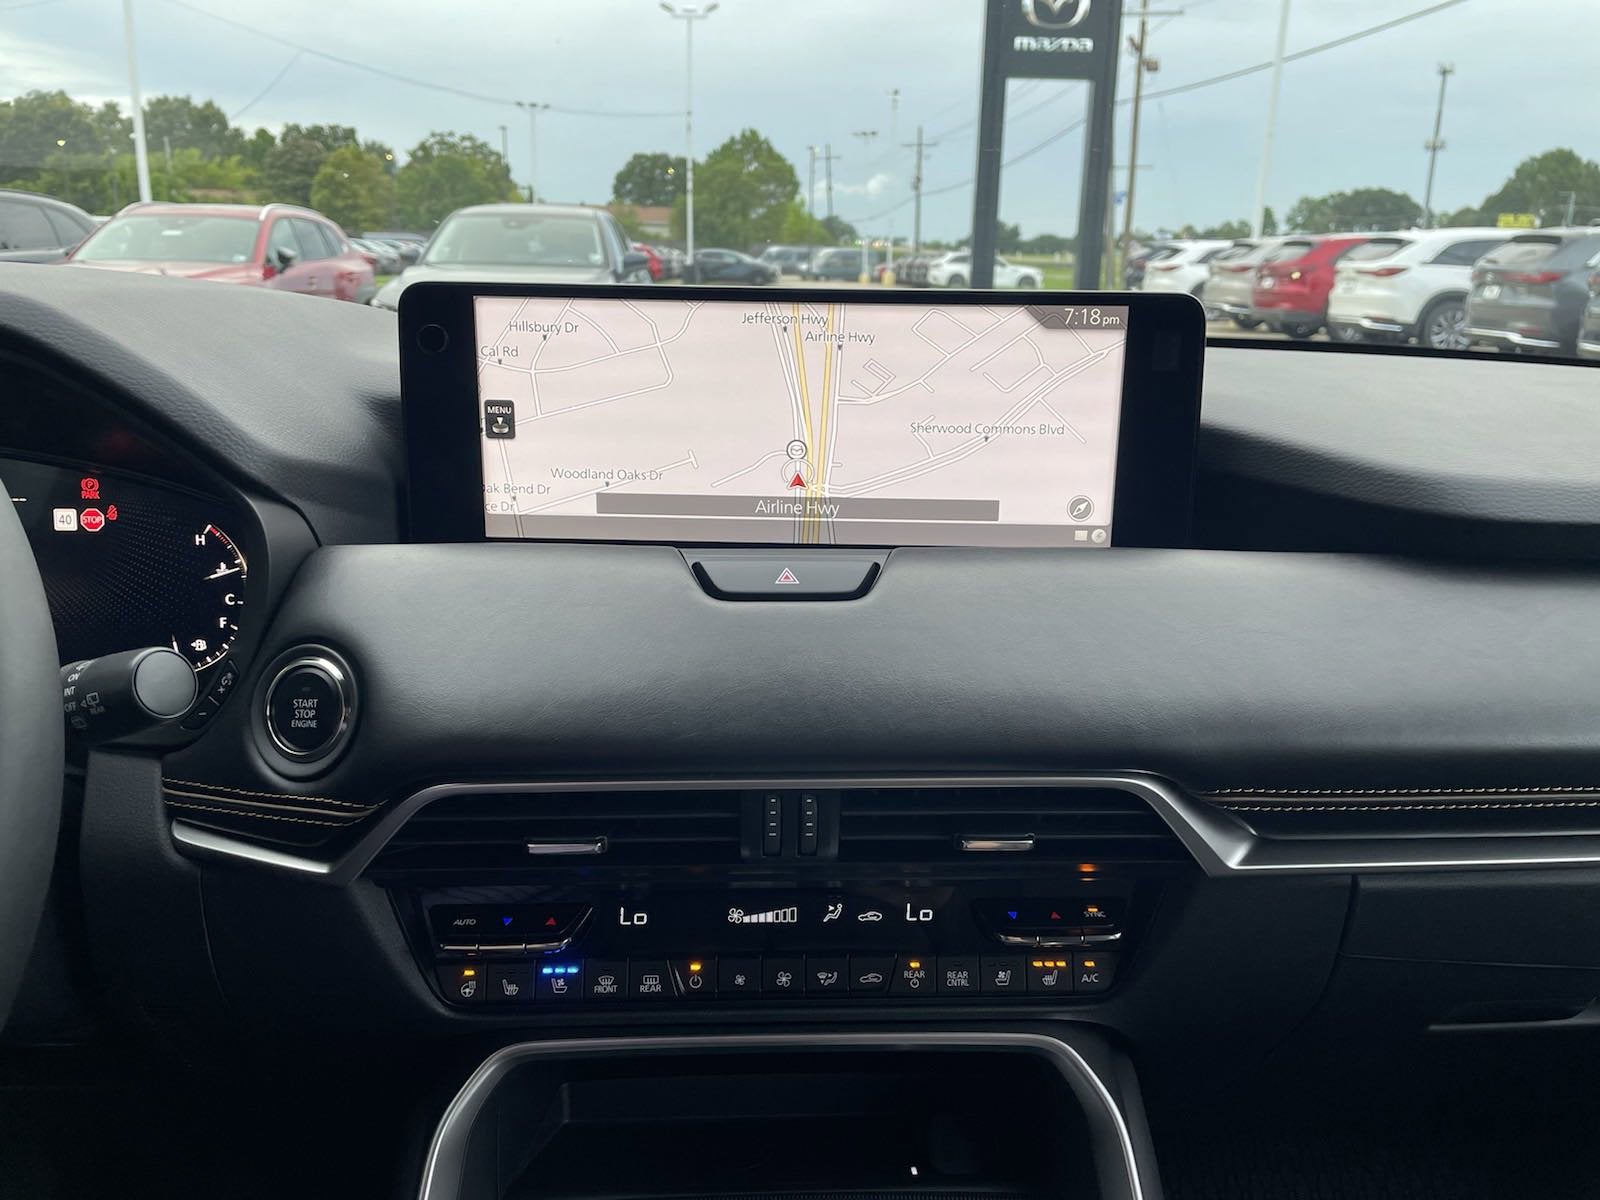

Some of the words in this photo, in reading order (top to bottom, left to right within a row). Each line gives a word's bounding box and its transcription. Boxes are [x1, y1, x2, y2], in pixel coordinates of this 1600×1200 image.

[742, 311, 798, 325] Jefferson
[801, 314, 829, 327] Hwy
[1064, 308, 1101, 325] 7:18
[1102, 316, 1120, 327] pm
[509, 320, 562, 336] Hillsbury
[564, 322, 579, 334] Dr
[805, 330, 845, 342] Airline
[849, 332, 876, 345] Hwy
[480, 345, 499, 358] Cal
[503, 346, 519, 357] Rd
[487, 406, 512, 415] MENU
[910, 421, 972, 434] Sherwood
[974, 423, 1037, 435] Commons
[1039, 423, 1066, 435] Blvd
[550, 467, 614, 480] Woodland
[617, 469, 647, 481] Oaks
[649, 469, 664, 481] Dr
[503, 482, 534, 495] Bend
[537, 484, 552, 495] Dr
[81, 490, 101, 499] PARK
[501, 500, 515, 512] Dr
[755, 499, 802, 515] Airline
[806, 501, 840, 519] Hwy
[58, 514, 72, 525] 40
[82, 515, 103, 525] STOP
[195, 534, 206, 546] H
[224, 593, 236, 606] C
[219, 616, 228, 629] F
[63, 686, 76, 697] INT
[292, 698, 319, 709] START
[294, 709, 317, 719] STOP
[291, 719, 318, 729] ENGINE
[620, 906, 648, 925] Lo
[906, 902, 934, 921] Lo
[453, 918, 477, 926] AUTO
[903, 970, 926, 979] REAR
[946, 970, 969, 979] REAR
[1081, 973, 1099, 983] A/C
[594, 984, 618, 993] FRONT
[640, 984, 662, 993] REAR
[946, 979, 970, 987] CNTRL
